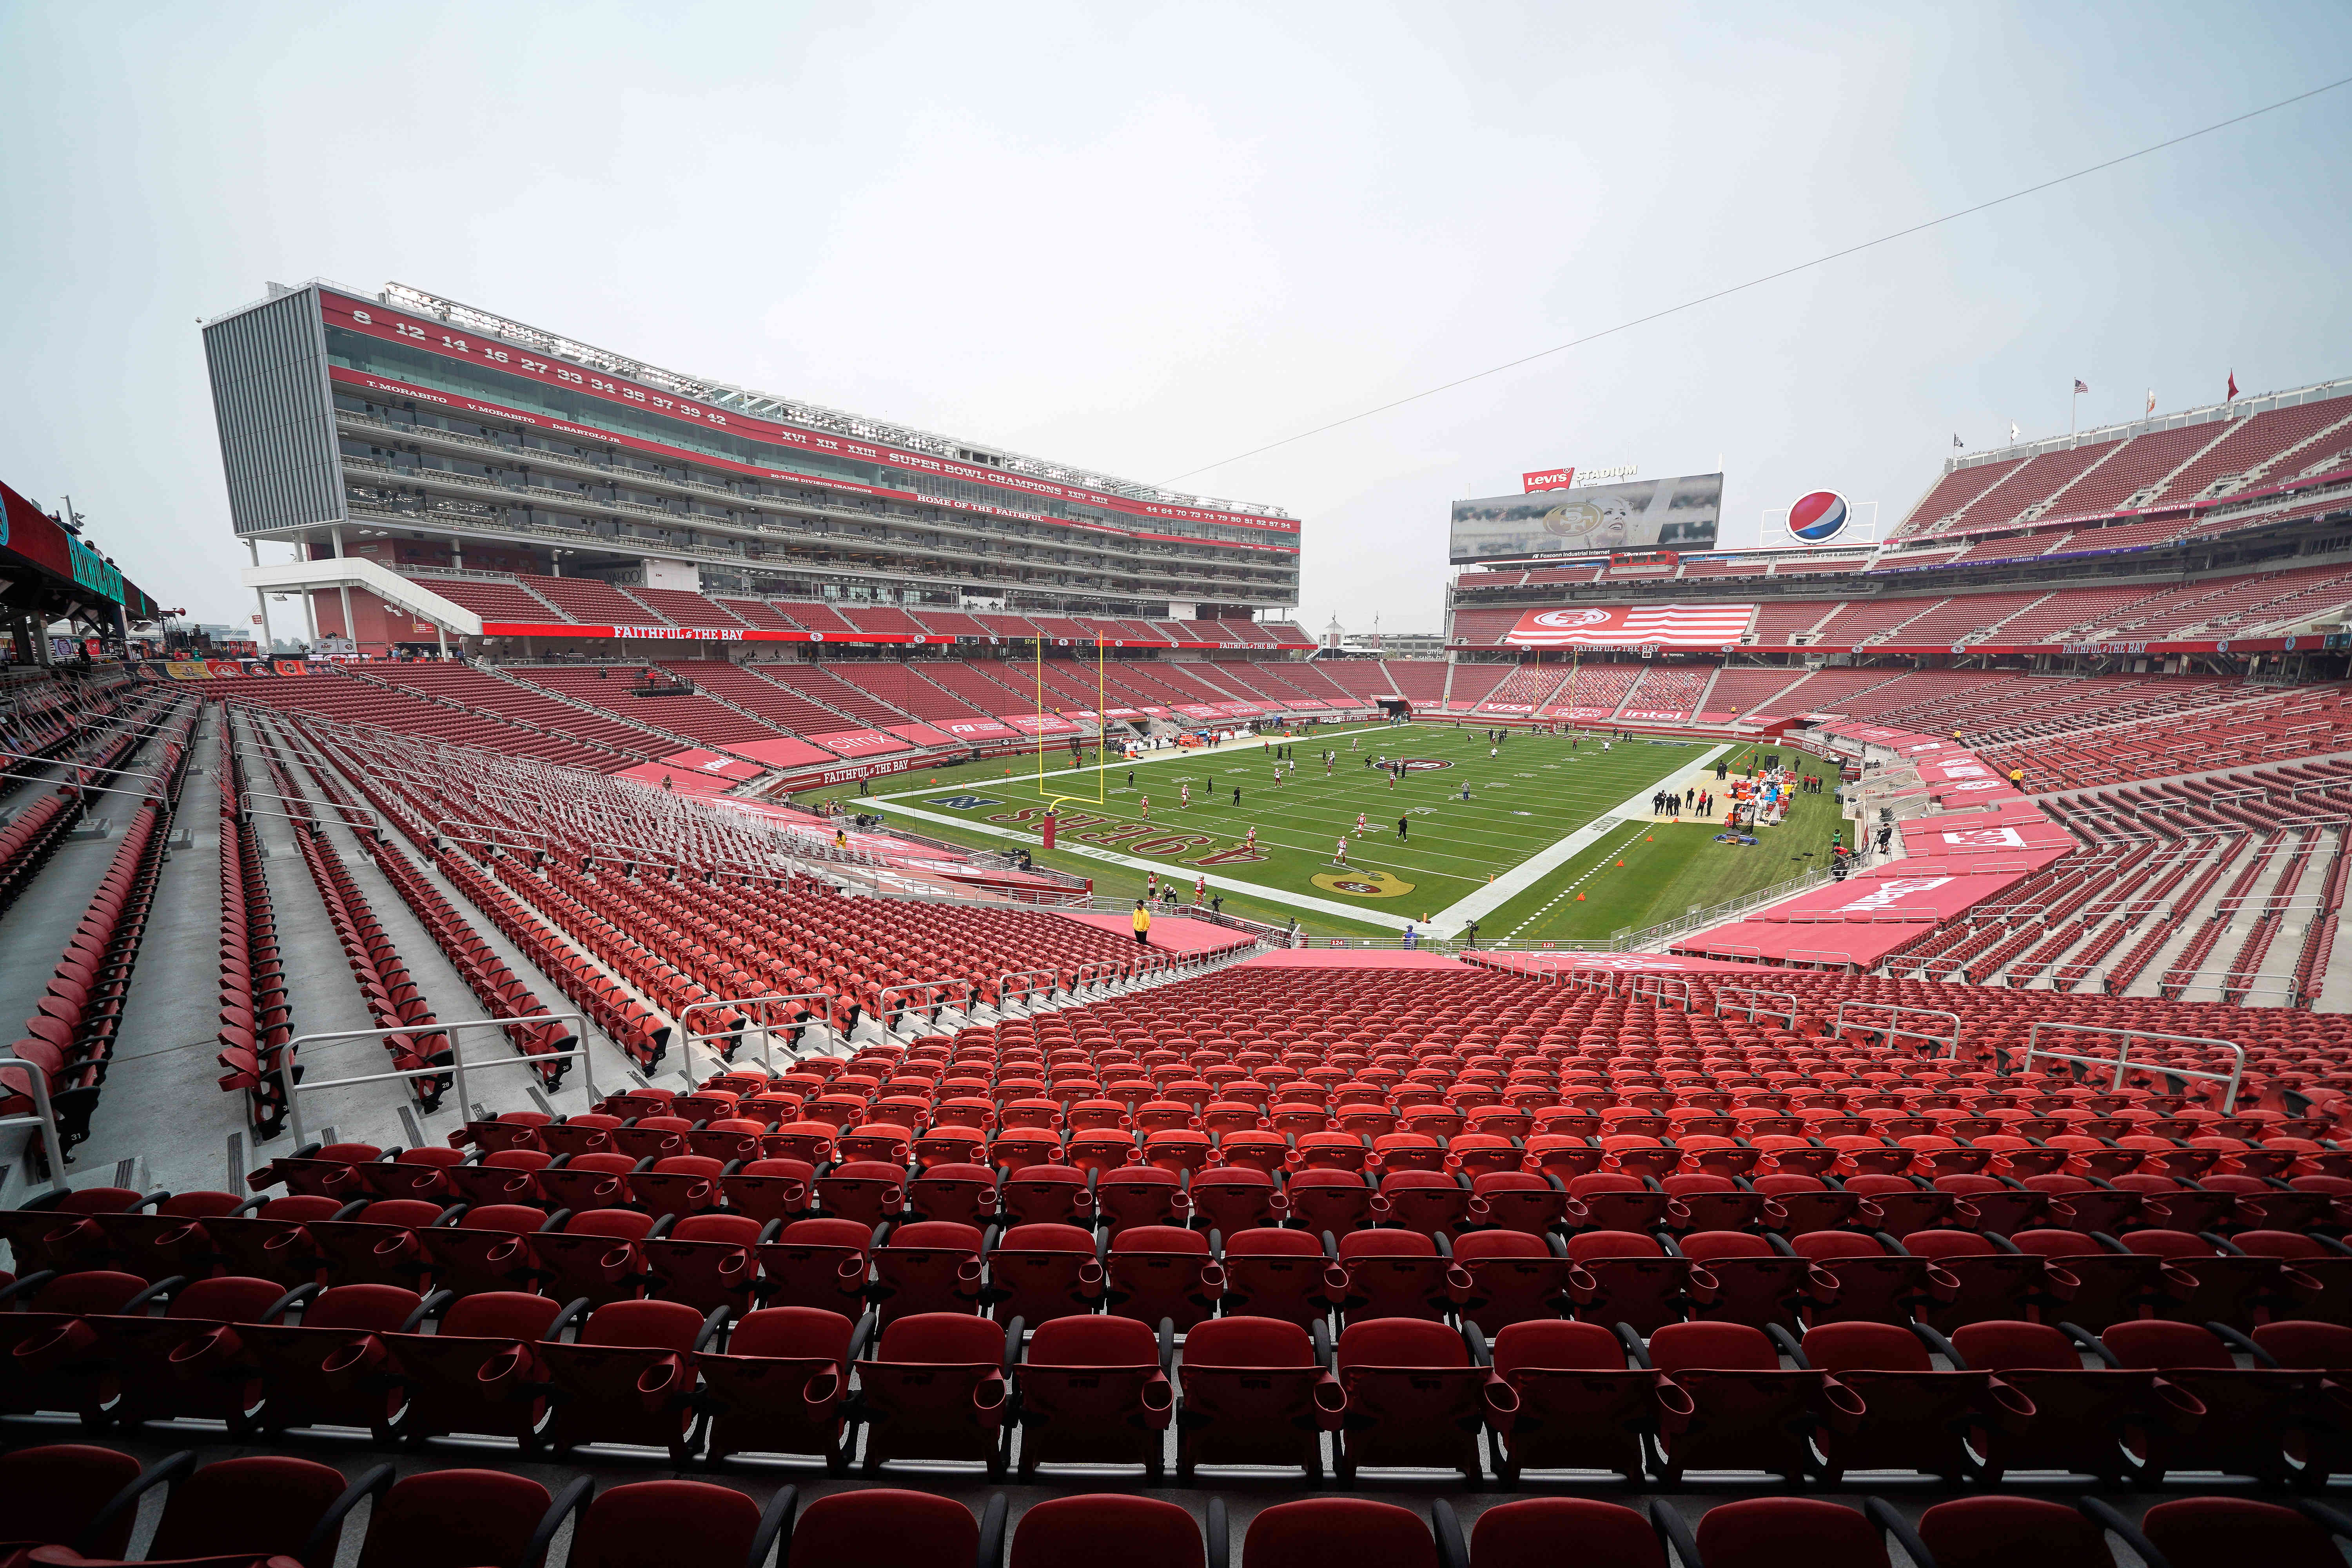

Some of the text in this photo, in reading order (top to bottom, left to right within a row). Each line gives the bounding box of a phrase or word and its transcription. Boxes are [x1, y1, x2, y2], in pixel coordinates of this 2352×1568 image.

[352, 310, 726, 425] 8 12 14 16 27 33 34 35 37 39 42
[379, 383, 447, 403] MORABITO
[478, 406, 535, 424] MORABITO
[782, 431, 806, 443] XVI
[816, 439, 838, 450] XIX
[848, 445, 876, 457] XXIII
[889, 453, 940, 470] SUPER
[944, 464, 985, 479] BOWL
[987, 474, 1062, 495] CHAMPIONS
[1576, 464, 1638, 481] STADIUM
[771, 474, 872, 493] 20-TIME DIVISION CHAMPIONS
[917, 495, 951, 506] HOME
[971, 504, 992, 514] THE
[996, 508, 1043, 522] FAITHFUL
[2153, 504, 2178, 512] XFINITY
[613, 626, 684, 639] FAITHFUL
[693, 628, 718, 640] THE
[721, 630, 744, 640] BAY
[2062, 643, 2102, 653] FAITHFUL
[2108, 643, 2125, 653] THE
[2127, 642, 2147, 653] BAY
[1486, 704, 1533, 712] VISA
[1624, 710, 1683, 719] intel
[828, 734, 895, 750] citrix
[824, 767, 869, 784] FAITHFUL
[875, 762, 891, 775] THE
[893, 759, 909, 772] BAY
